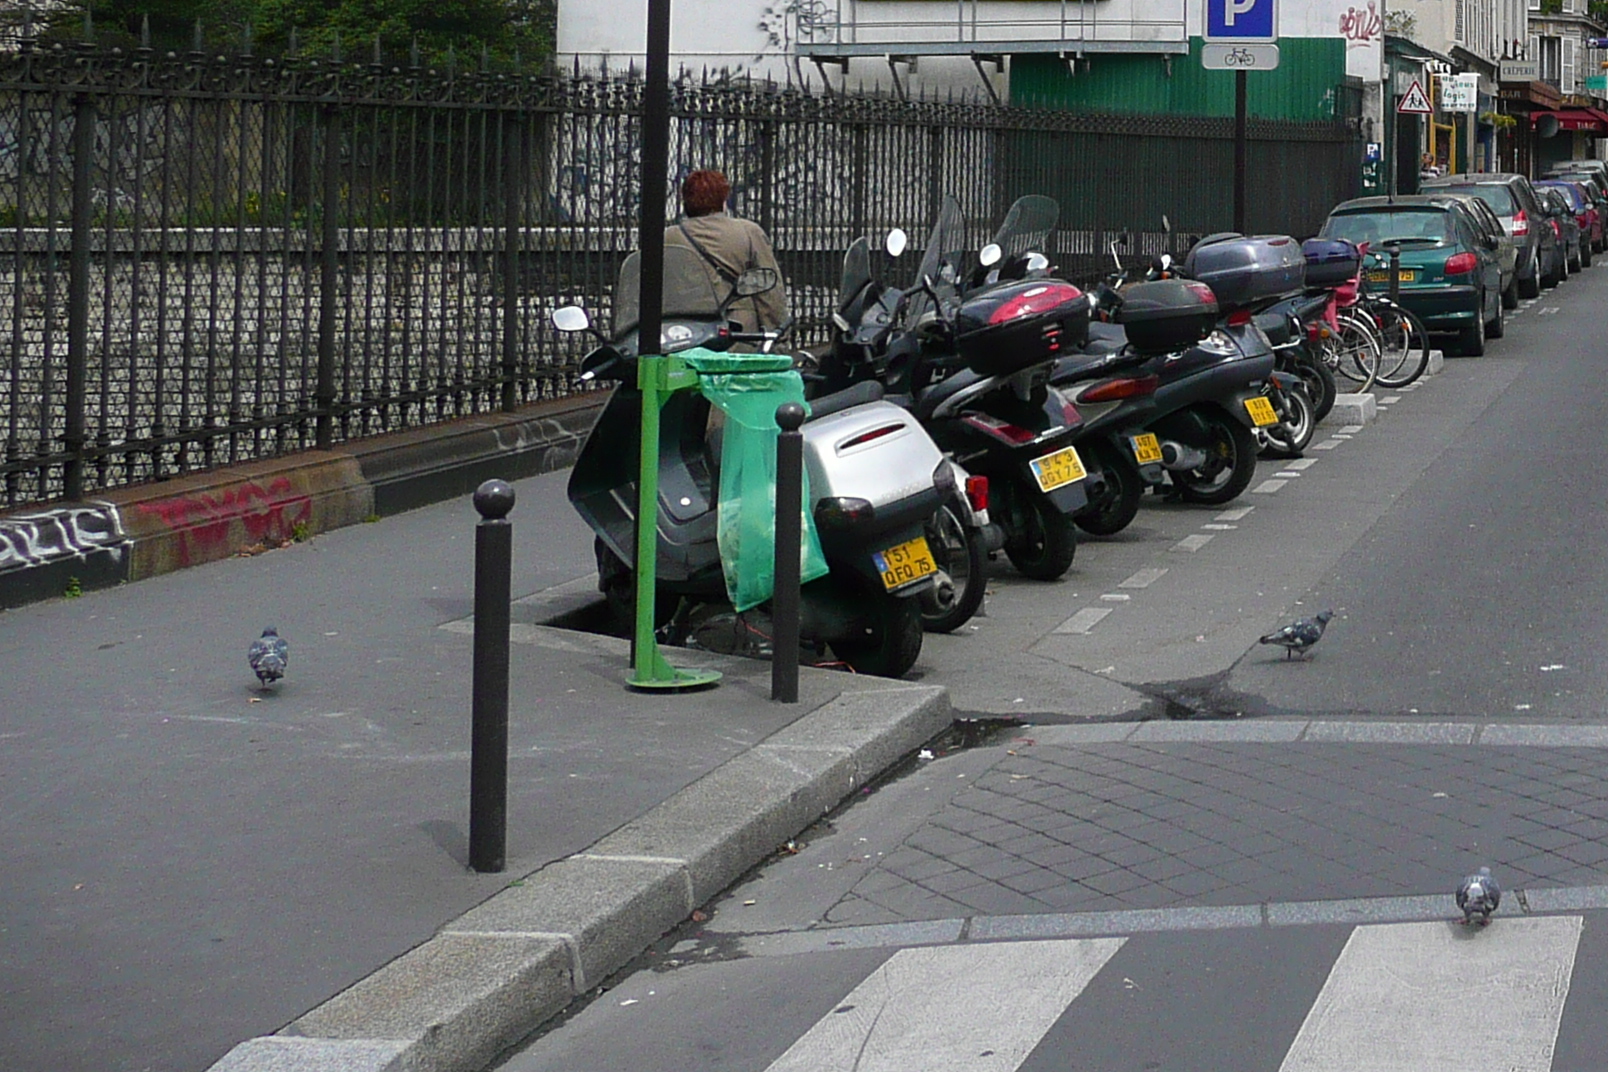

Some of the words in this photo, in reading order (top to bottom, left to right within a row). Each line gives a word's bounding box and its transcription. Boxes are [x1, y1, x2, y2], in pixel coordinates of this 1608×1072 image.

[1443, 88, 1466, 103] logis
[1500, 90, 1520, 99] BAR
[1043, 452, 1073, 470] 943
[1065, 462, 1081, 477] 75
[884, 545, 911, 566] 151
[885, 564, 915, 585] QFQ
[914, 557, 931, 573] 75
